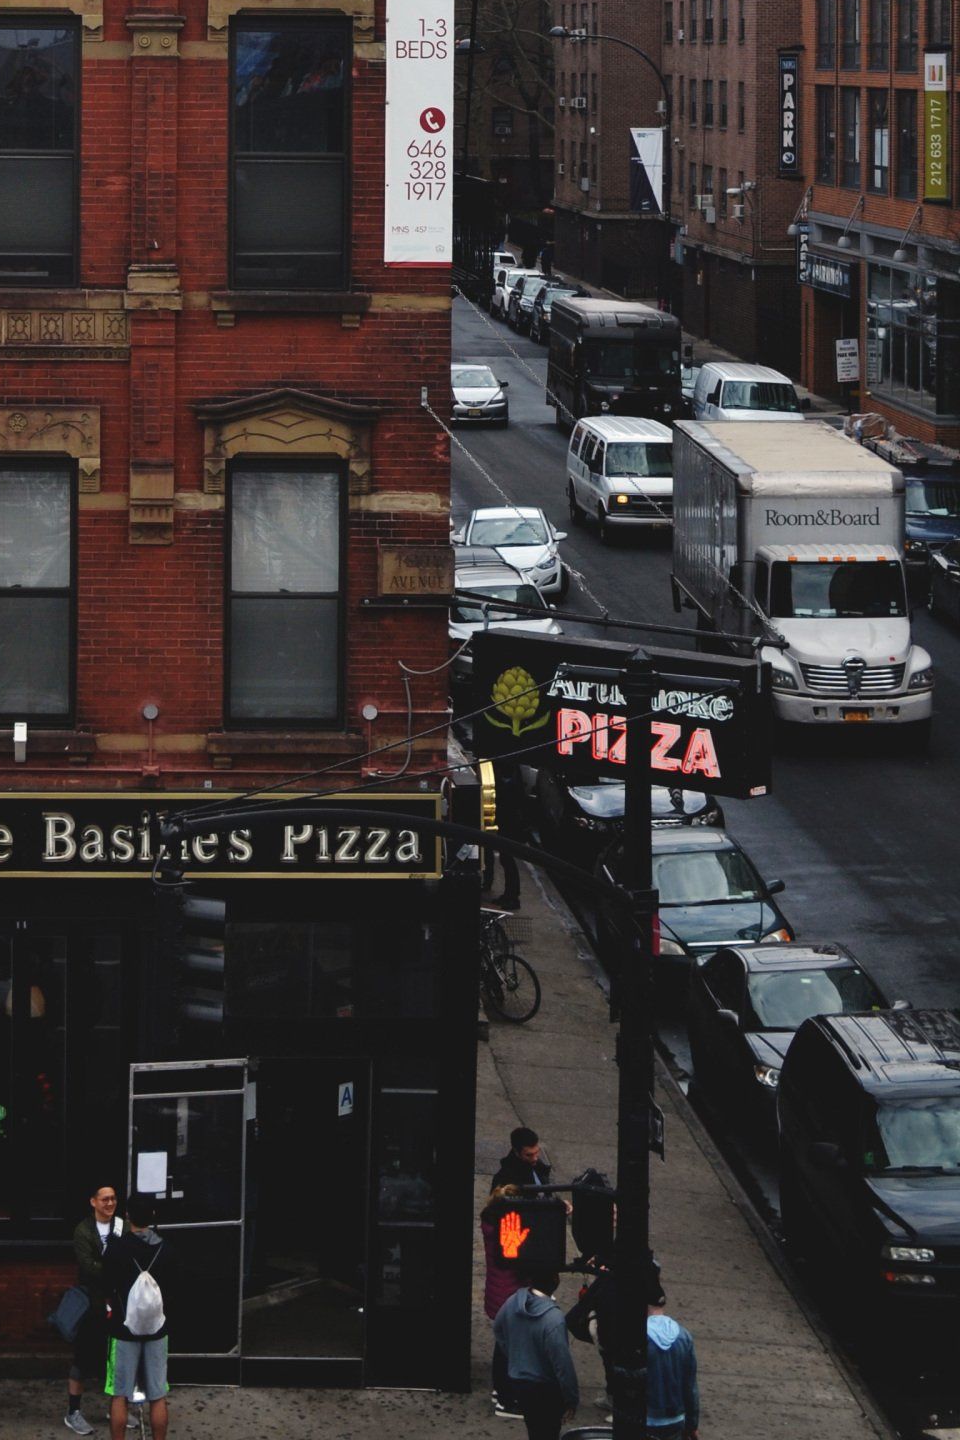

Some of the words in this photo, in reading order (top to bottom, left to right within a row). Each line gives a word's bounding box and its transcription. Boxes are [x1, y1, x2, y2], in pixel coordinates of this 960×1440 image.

[418, 18, 447, 37] 1-3
[395, 40, 448, 59] BEDS
[783, 73, 795, 148] PARK
[930, 98, 942, 129] 1717
[406, 139, 446, 158] 646
[930, 133, 942, 158] 633
[409, 160, 446, 179] 328
[930, 161, 942, 186] 212
[403, 181, 446, 201] 1917
[280, 823, 424, 863] Pizza
[341, 1086, 352, 1108] A
